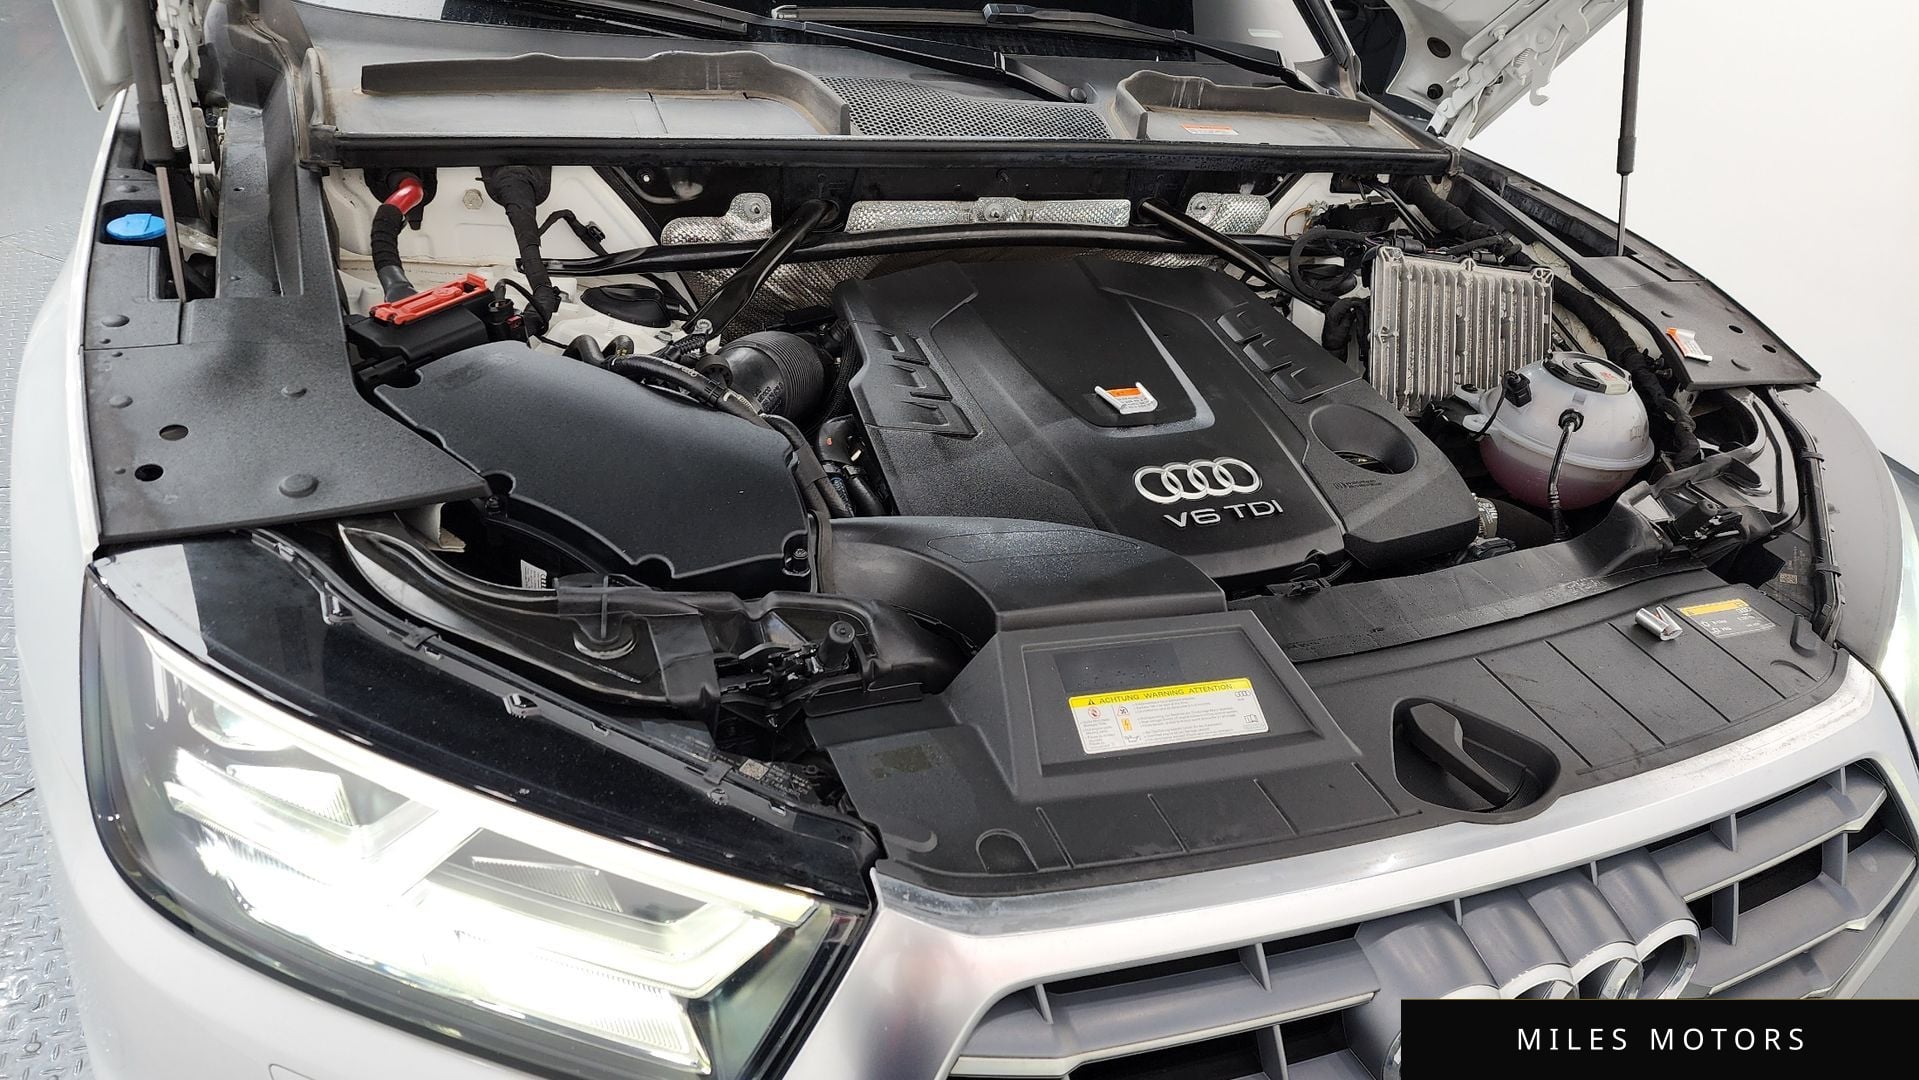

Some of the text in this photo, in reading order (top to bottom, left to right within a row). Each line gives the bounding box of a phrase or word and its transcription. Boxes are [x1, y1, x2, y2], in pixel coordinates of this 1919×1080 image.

[1163, 500, 1284, 528] V6 TDI
[1099, 684, 1233, 704] ACHTUNG WARNING ATTENTION
